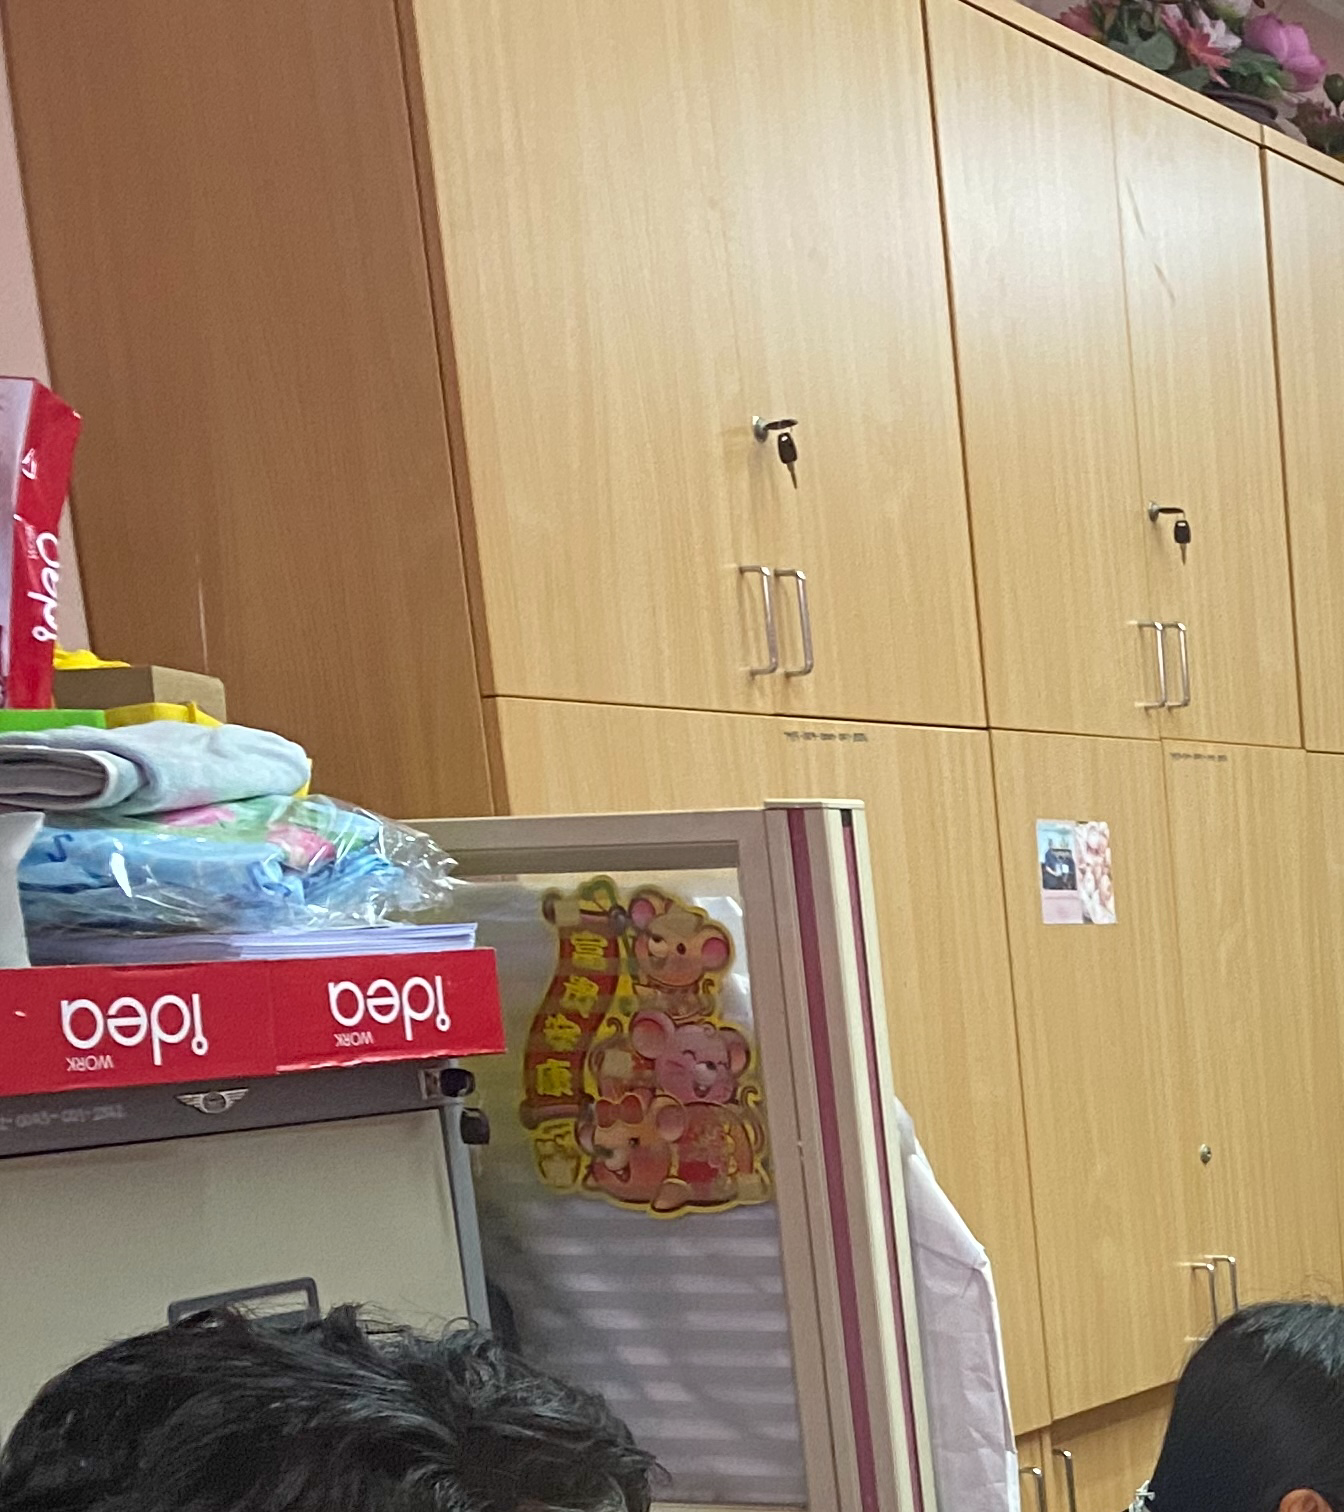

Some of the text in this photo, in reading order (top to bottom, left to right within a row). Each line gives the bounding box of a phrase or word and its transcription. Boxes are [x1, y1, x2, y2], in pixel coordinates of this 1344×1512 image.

[328, 975, 451, 1041] idea
[60, 993, 208, 1066] idea
[333, 1030, 374, 1047] WORK
[66, 1055, 113, 1072] WORK
